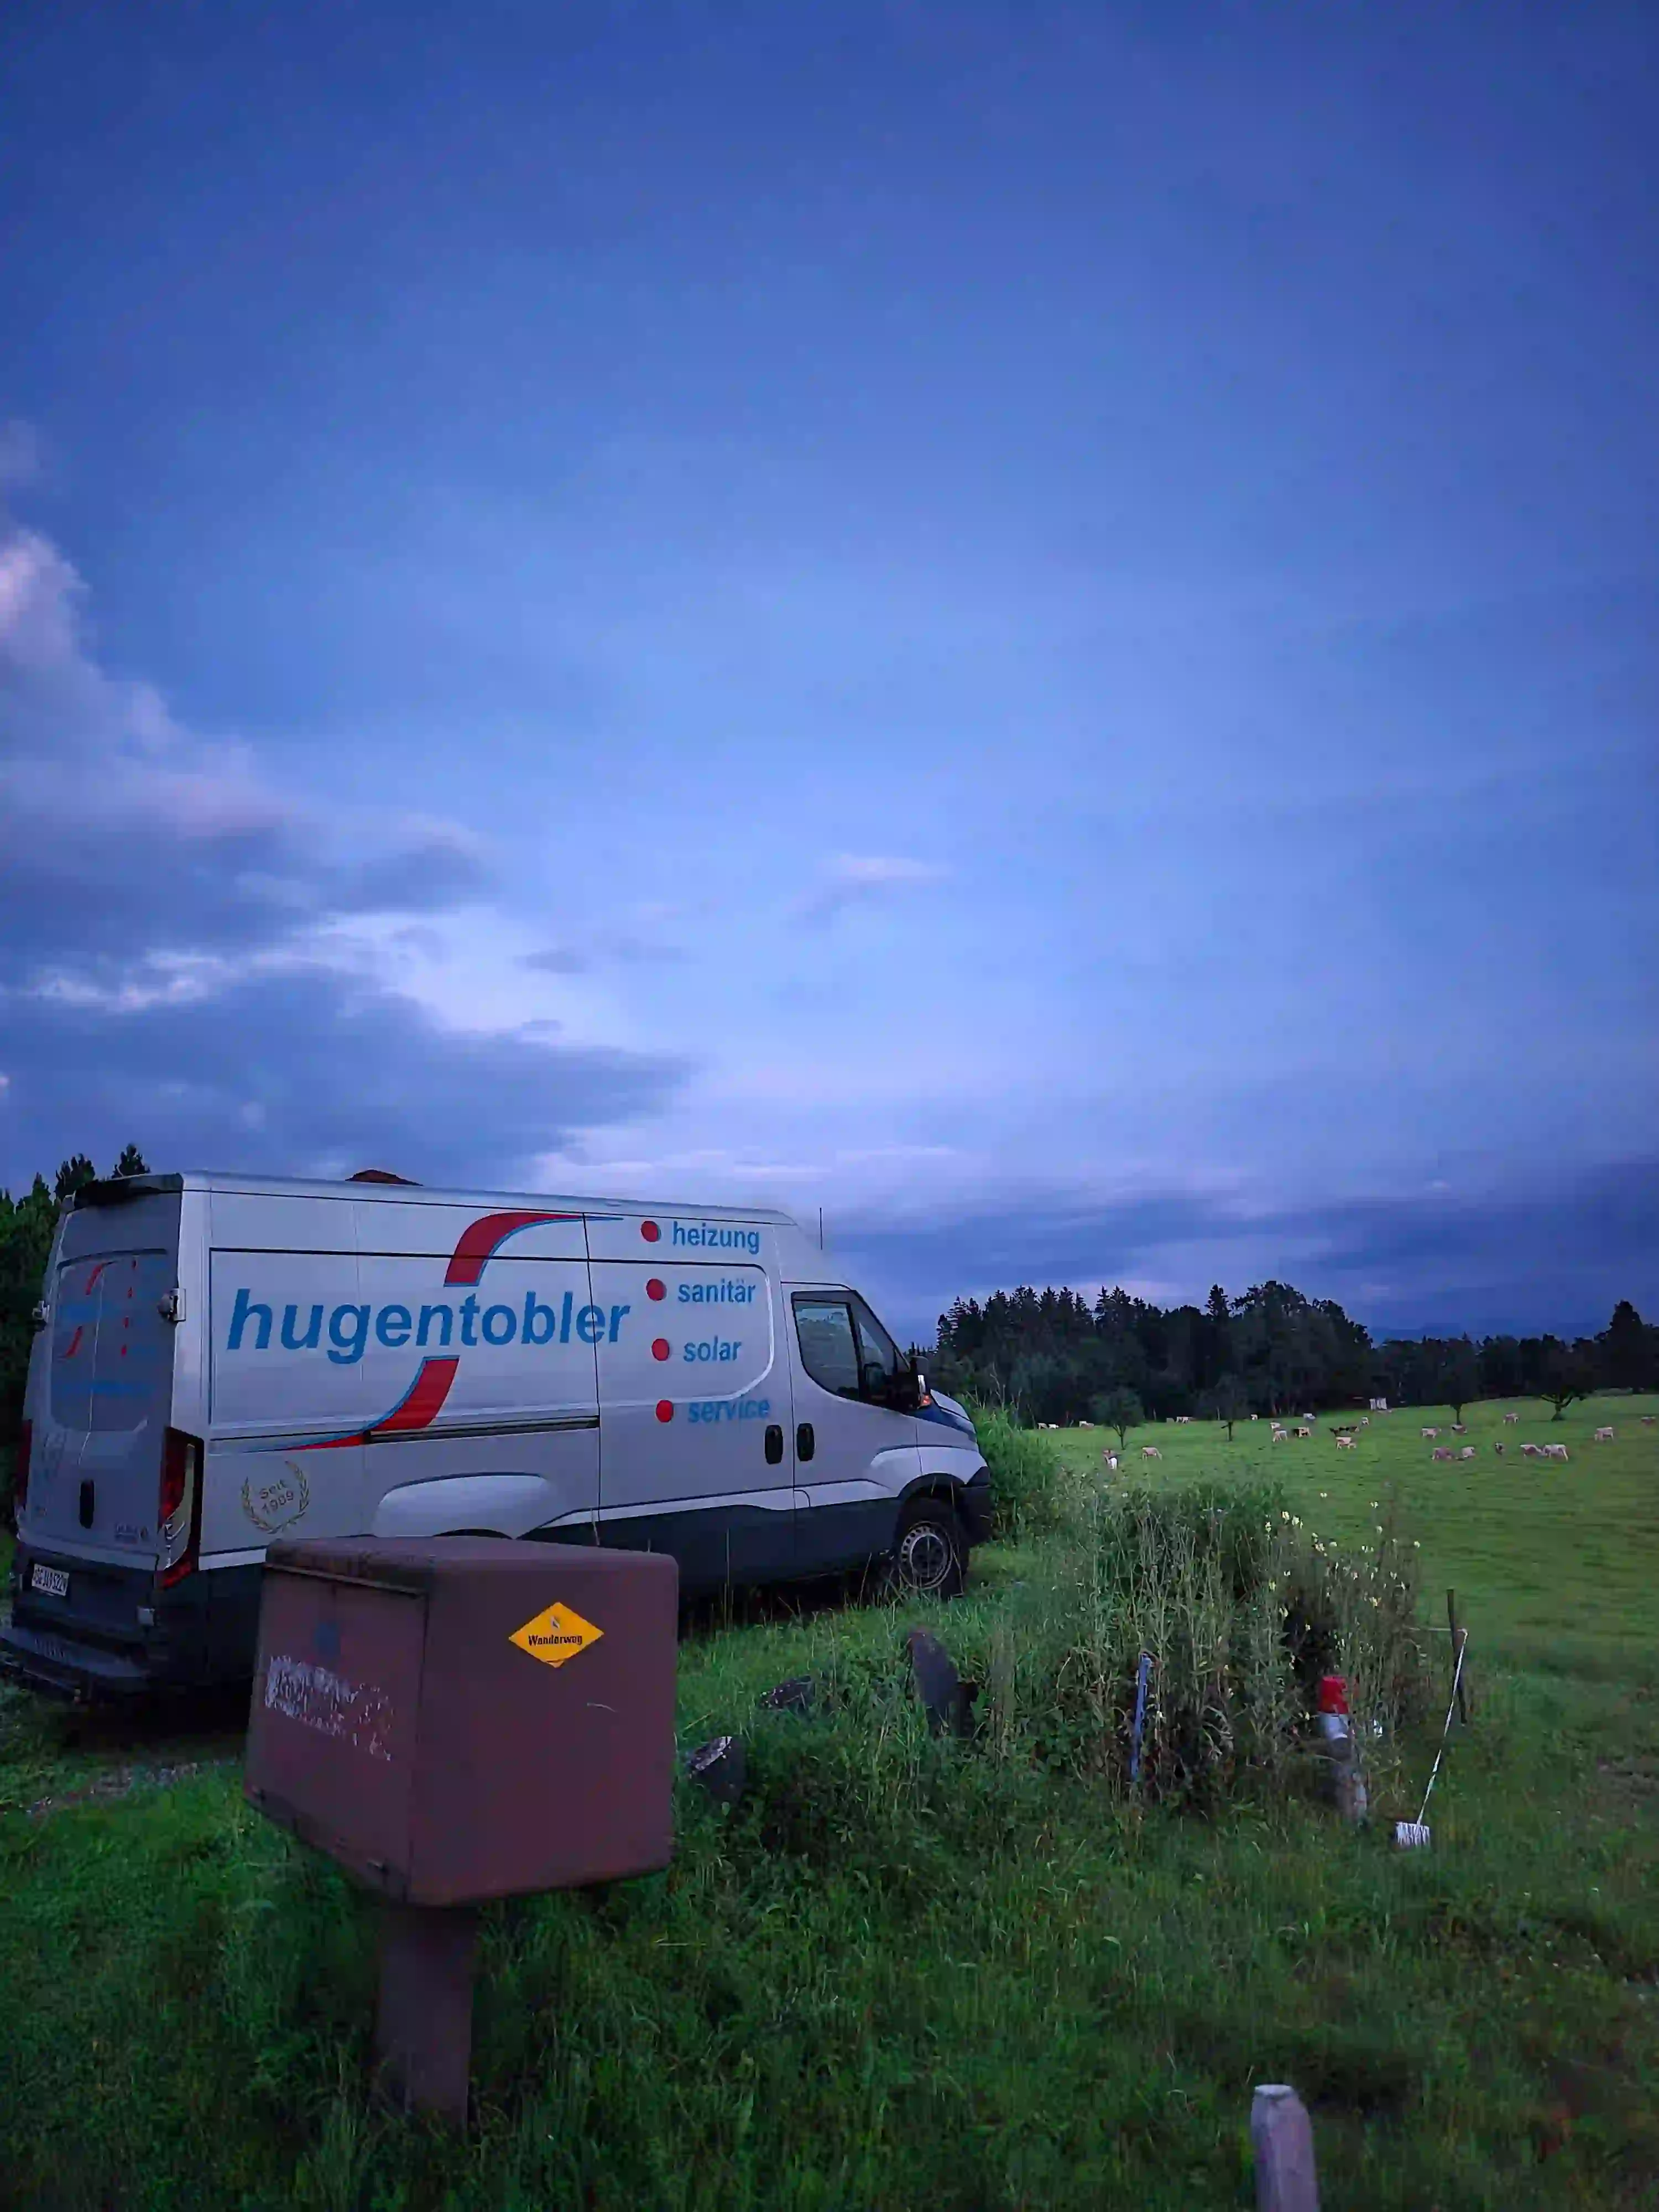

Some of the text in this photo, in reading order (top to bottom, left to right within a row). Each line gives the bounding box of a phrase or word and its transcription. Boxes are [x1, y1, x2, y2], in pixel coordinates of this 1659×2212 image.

[672, 1220, 760, 1255] heizung
[677, 1278, 756, 1303] sanitär
[227, 1288, 631, 1364] hugentobler
[682, 1335, 742, 1363] solar
[687, 1399, 770, 1423] service
[529, 1634, 583, 1646] Wanderweg
